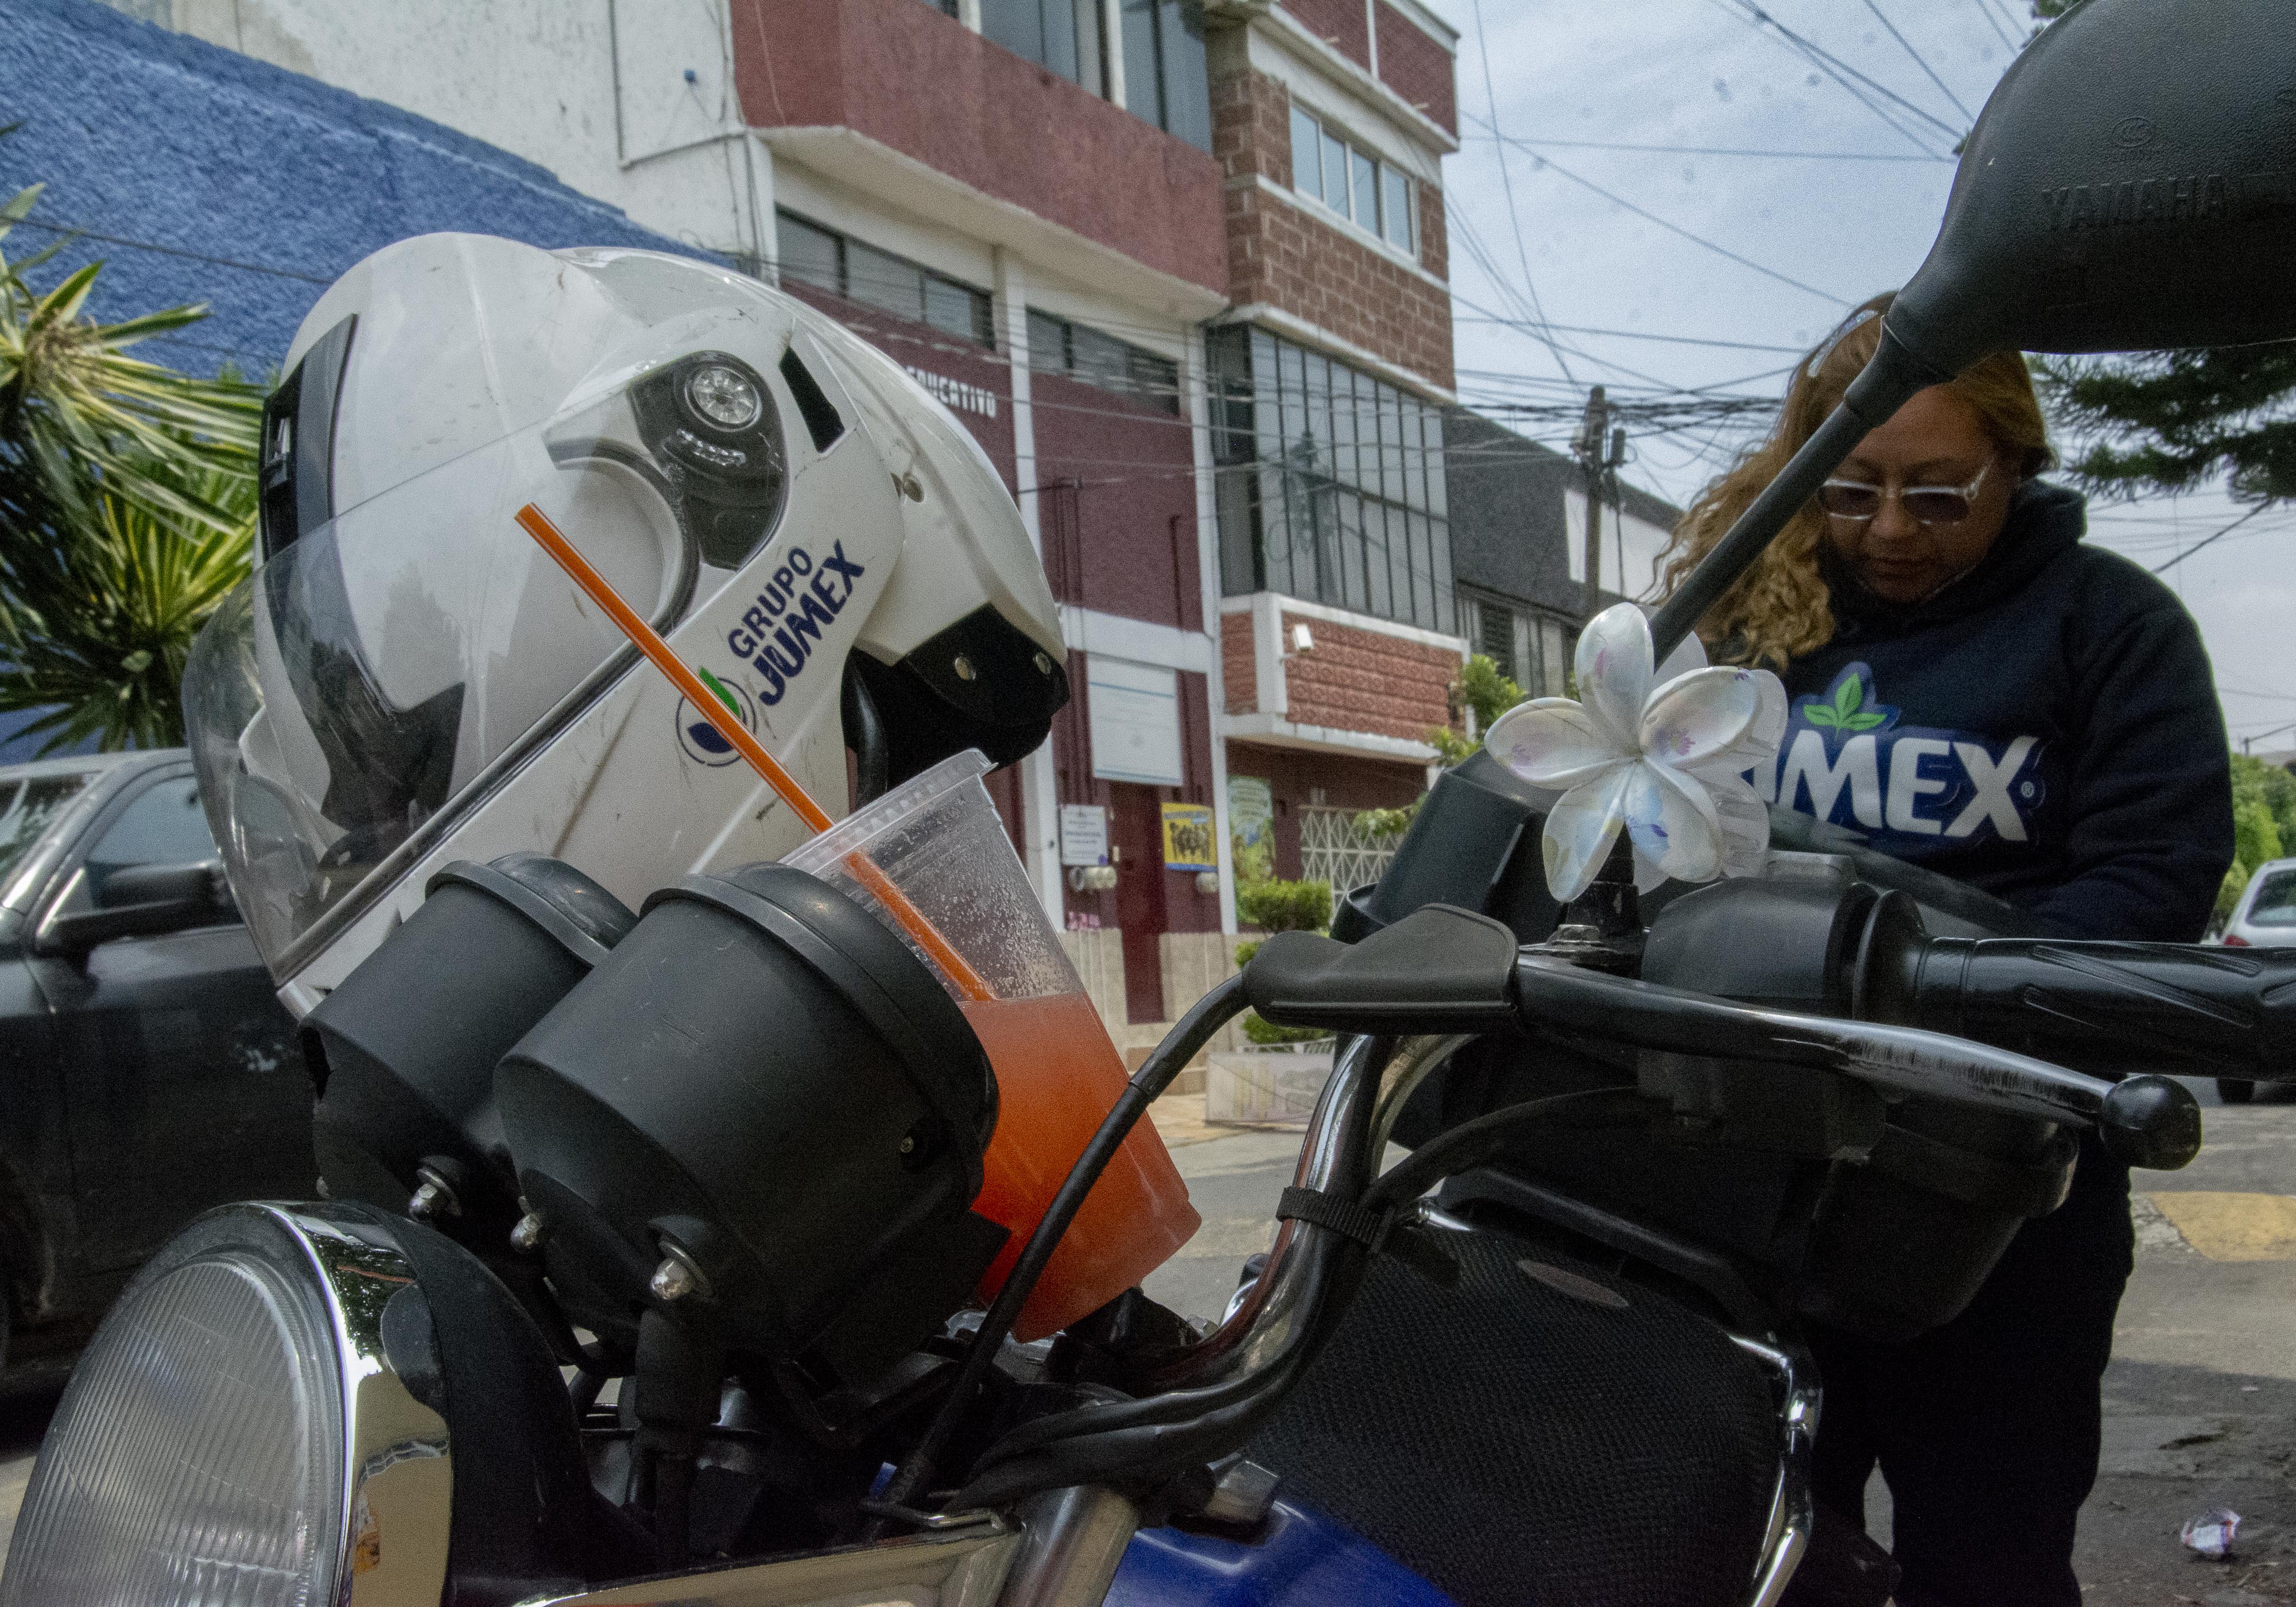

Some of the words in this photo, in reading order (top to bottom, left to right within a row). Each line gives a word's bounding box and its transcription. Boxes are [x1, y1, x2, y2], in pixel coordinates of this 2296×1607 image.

[2041, 173, 2225, 231] YAMAHA
[728, 547, 812, 659] GRUPO
[753, 538, 865, 706] JUMEX
